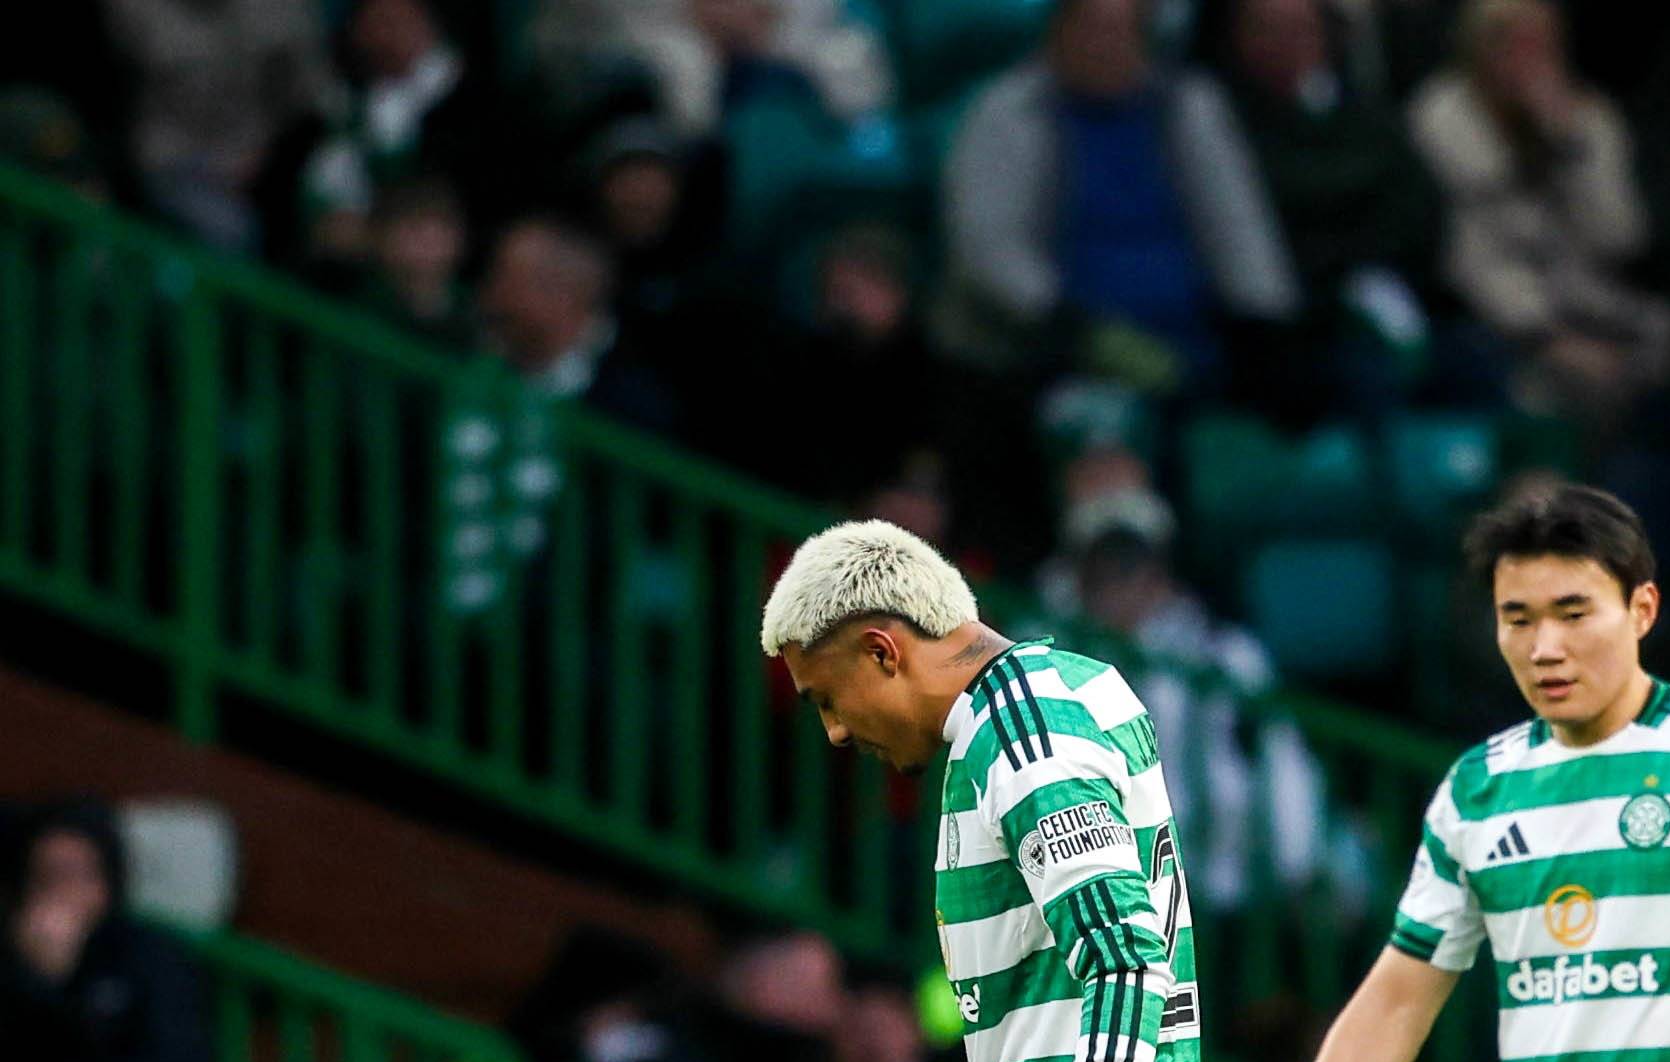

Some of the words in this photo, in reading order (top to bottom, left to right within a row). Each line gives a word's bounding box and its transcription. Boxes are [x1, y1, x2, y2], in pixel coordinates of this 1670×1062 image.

[1039, 804, 1093, 841] CELTIC
[1093, 801, 1112, 825] FC
[1047, 824, 1134, 864] FOUNDATION
[1506, 952, 1659, 1005] dafabet
